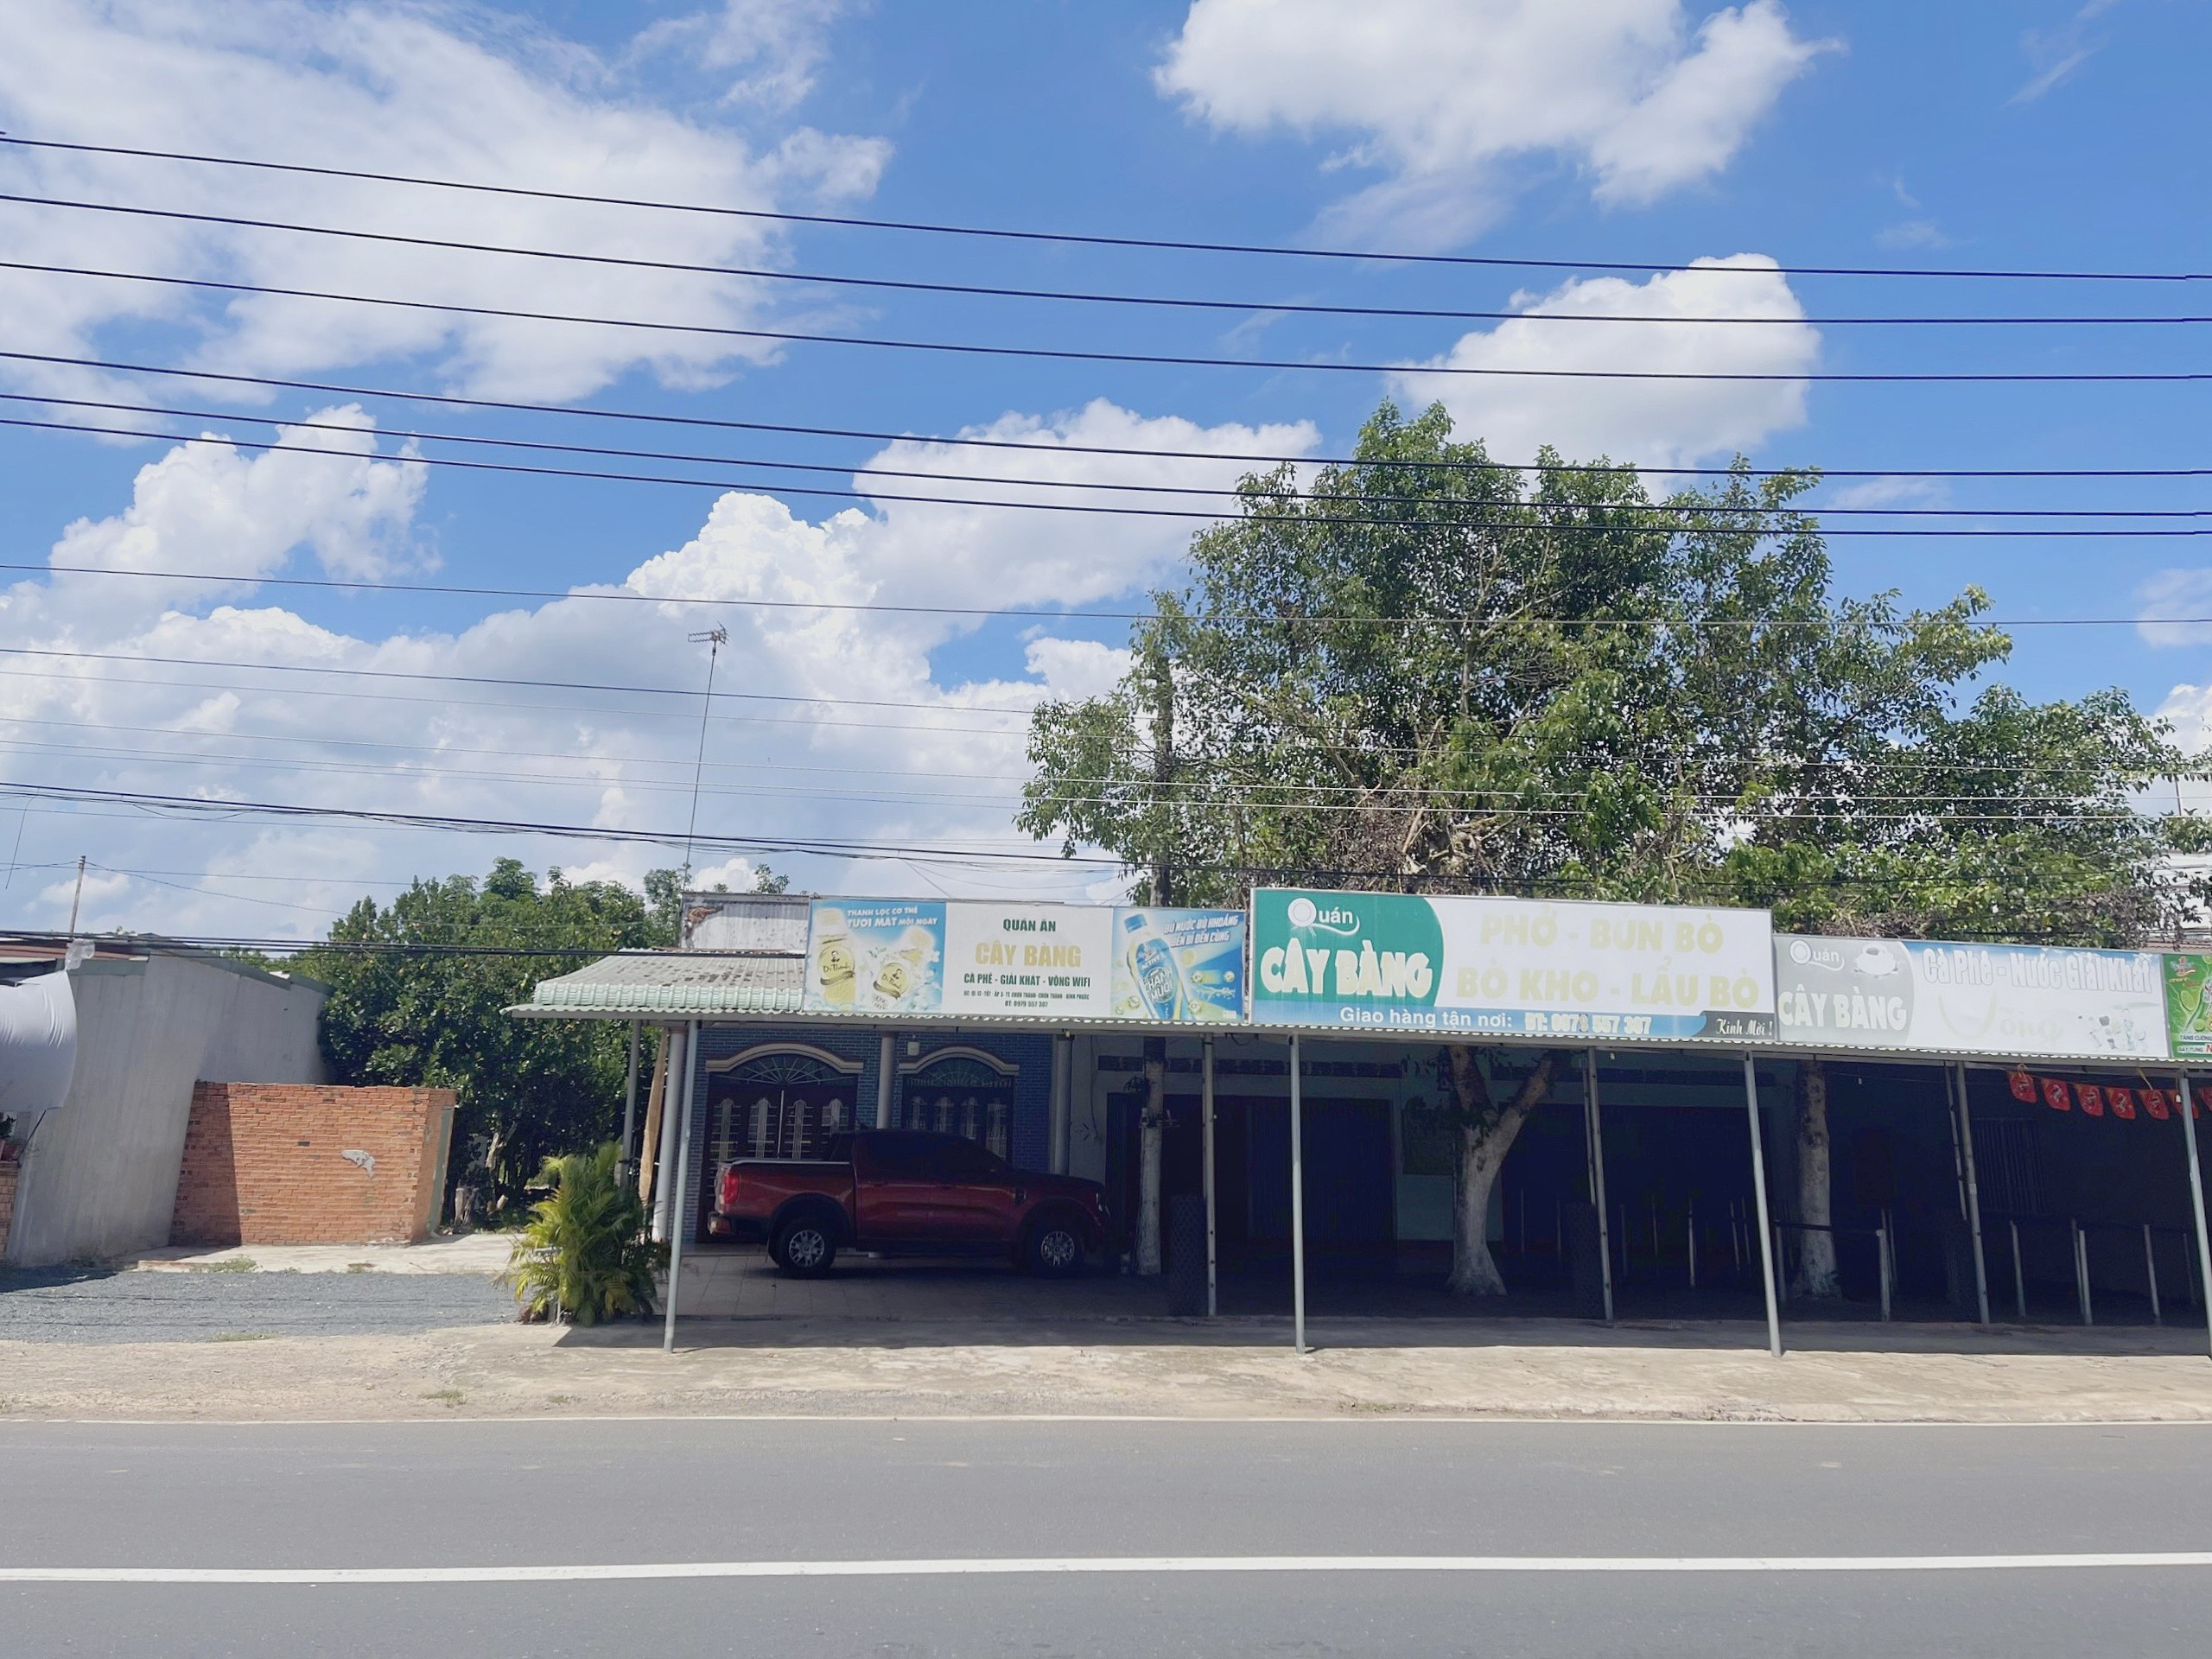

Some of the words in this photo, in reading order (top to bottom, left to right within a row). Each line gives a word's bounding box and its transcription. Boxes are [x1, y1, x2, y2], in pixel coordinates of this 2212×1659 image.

[1003, 918, 1036, 931] QUÁN
[1480, 902, 1557, 948] PHỞ
[1675, 914, 1724, 954] BÒ
[975, 940, 1017, 966] CÂY
[1024, 943, 1082, 968] BÀNG
[1261, 938, 1331, 994] CÂY
[1335, 940, 1433, 999] BÀNG
[1922, 947, 1951, 984] Cà
[1953, 950, 1993, 986] Phê
[1072, 977, 1090, 988] WIFI
[1456, 958, 1509, 1001] BÒ
[1519, 968, 1599, 1002] KHO
[1631, 956, 1699, 1006] LẨU
[1709, 968, 1759, 1009] BÒ
[1340, 1007, 1384, 1024] Giao
[1389, 1008, 1436, 1028] hàng
[1442, 1010, 1471, 1031] tận
[1478, 1012, 1512, 1028] nơi:
[1777, 983, 1827, 1027] CÂY
[1833, 986, 1907, 1031] BÀNG
